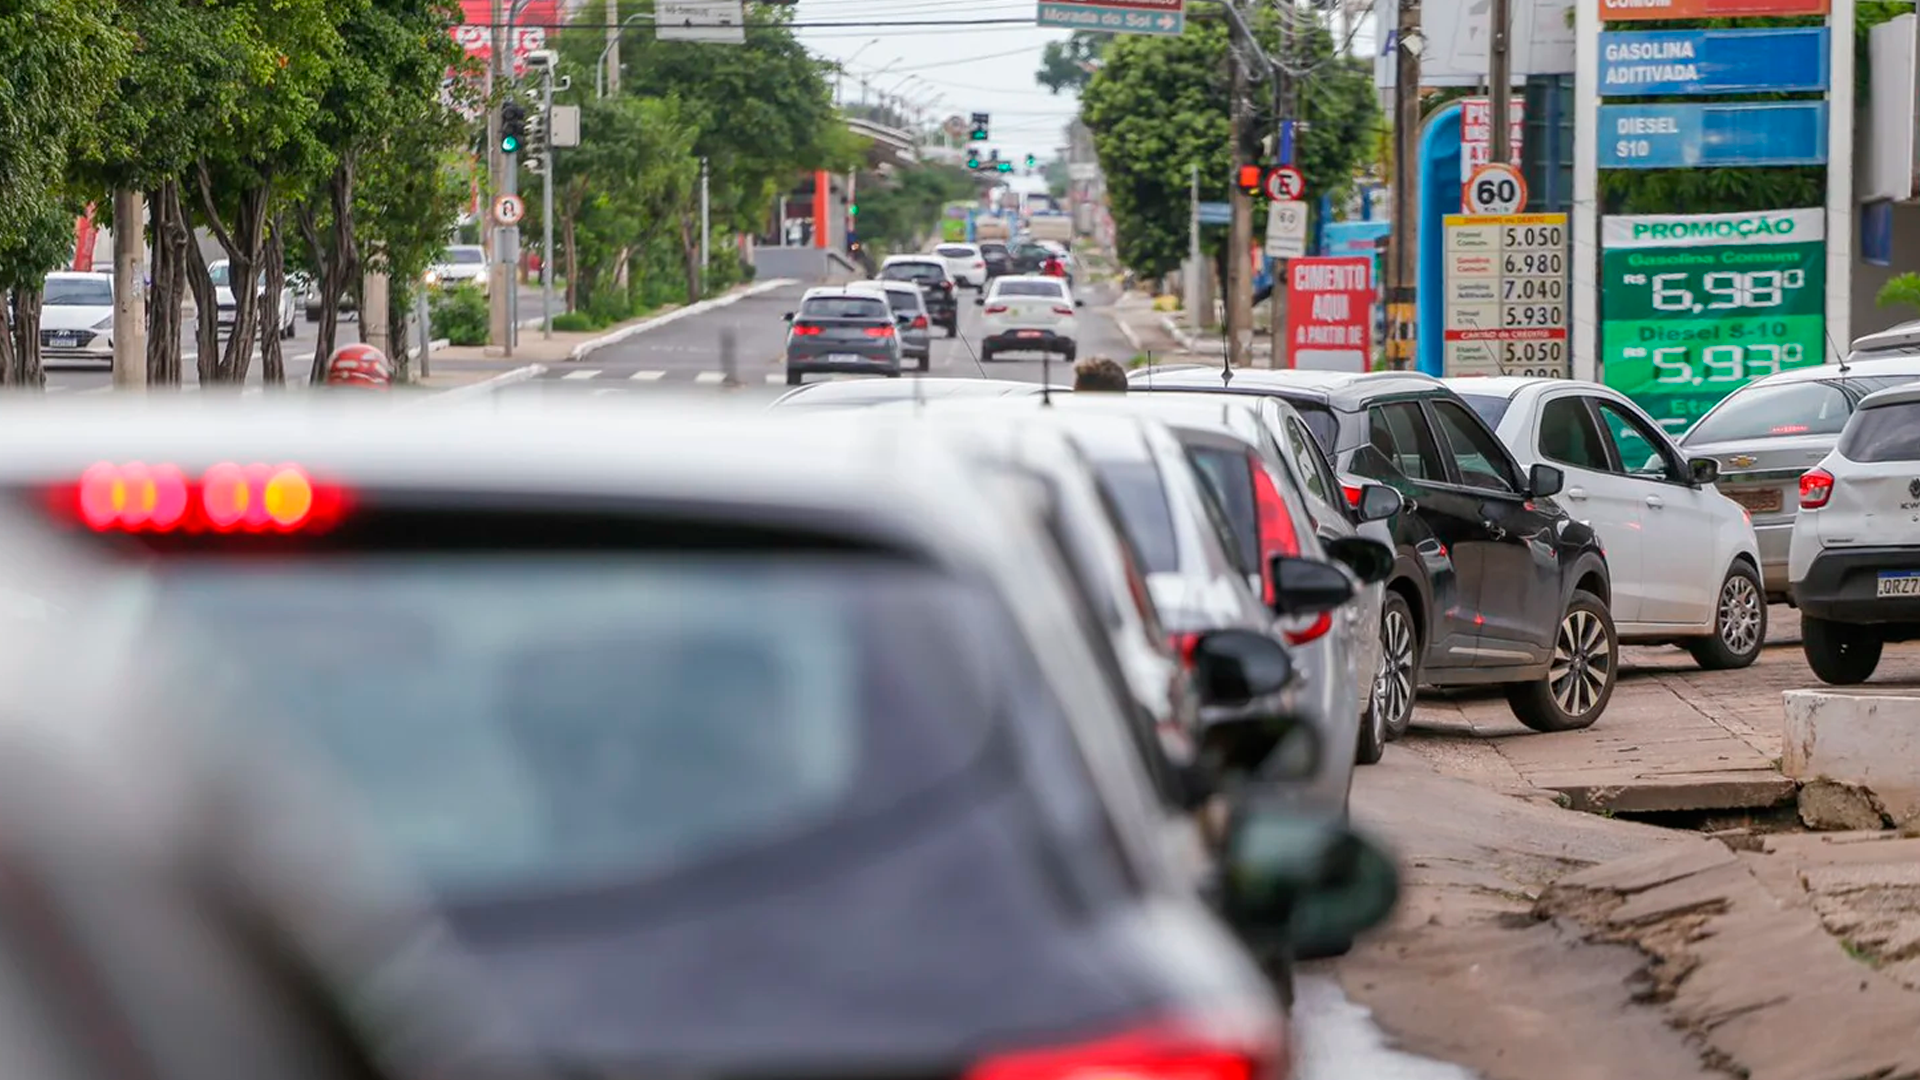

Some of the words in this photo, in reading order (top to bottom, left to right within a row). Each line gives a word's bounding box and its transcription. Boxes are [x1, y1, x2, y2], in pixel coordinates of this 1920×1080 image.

[1043, 8, 1097, 23] Morada
[1102, 12, 1121, 24] do
[1126, 13, 1150, 27] Sol
[1606, 41, 1693, 60] GASOLINA
[1606, 65, 1697, 83] ADITIVADA
[1617, 117, 1678, 134] DIESEL
[1617, 141, 1649, 157] S10
[1477, 180, 1516, 205] 60
[1505, 227, 1560, 247] 5.050
[1633, 217, 1794, 239] PROMOÇÃO
[1505, 254, 1560, 273] 6.980
[1628, 252, 1714, 266] Gasolina
[1722, 251, 1800, 264] Comum
[1294, 265, 1366, 290] CIMENTO
[1623, 274, 1647, 285] R$
[1505, 280, 1560, 299] 7.040
[1311, 294, 1349, 320] AQUI
[1506, 307, 1560, 326] 5.930
[1296, 326, 1306, 343] A
[1309, 327, 1345, 344] PARTIR
[1348, 327, 1363, 344] DE
[1639, 325, 1720, 341] Diesel
[1729, 322, 1786, 338] S-10
[1505, 342, 1560, 361] 5.050
